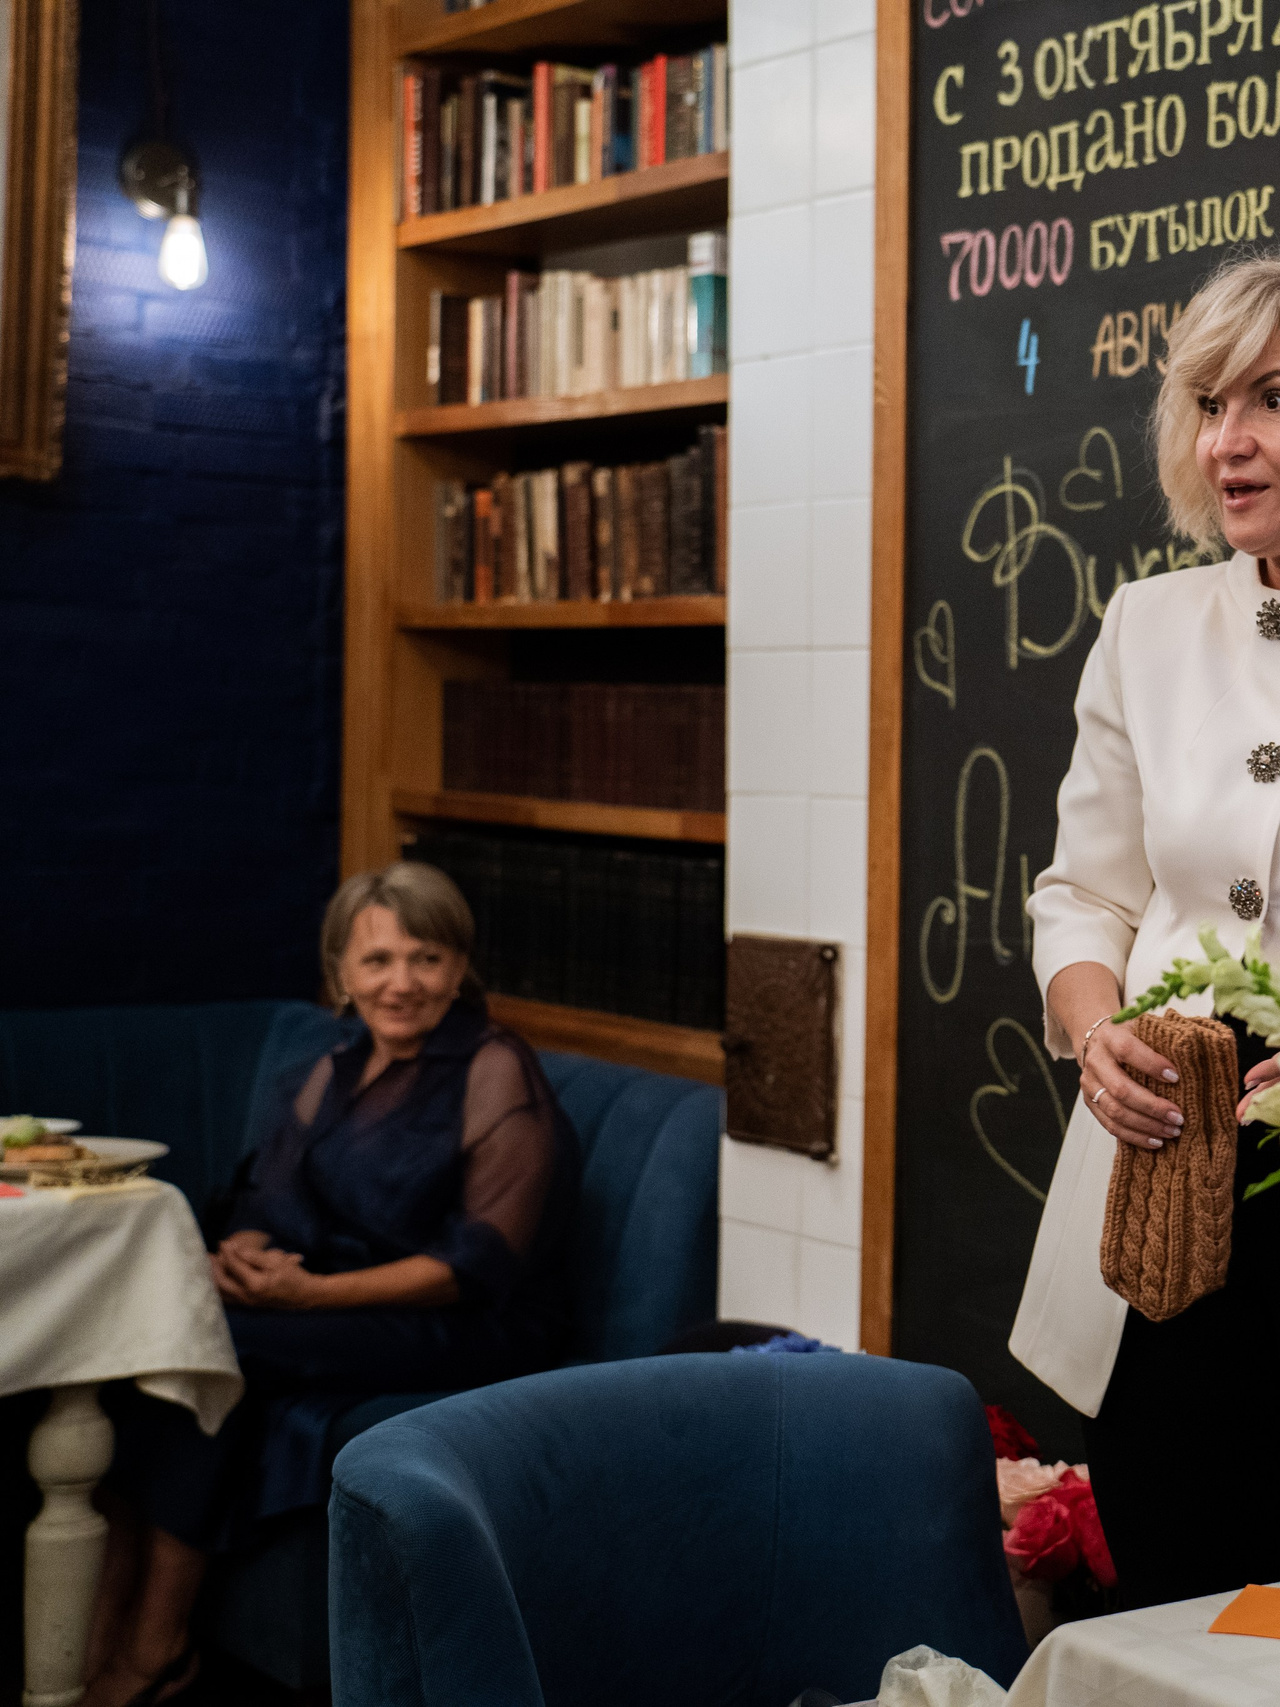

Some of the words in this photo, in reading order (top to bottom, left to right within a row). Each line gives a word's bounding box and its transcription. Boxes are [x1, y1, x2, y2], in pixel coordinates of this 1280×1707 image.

[933, 64, 965, 125] С
[997, 39, 1024, 106] 3
[939, 216, 1074, 301] 70000
[1089, 184, 1274, 272] БУТЫЛОК
[1016, 317, 1040, 395] 4
